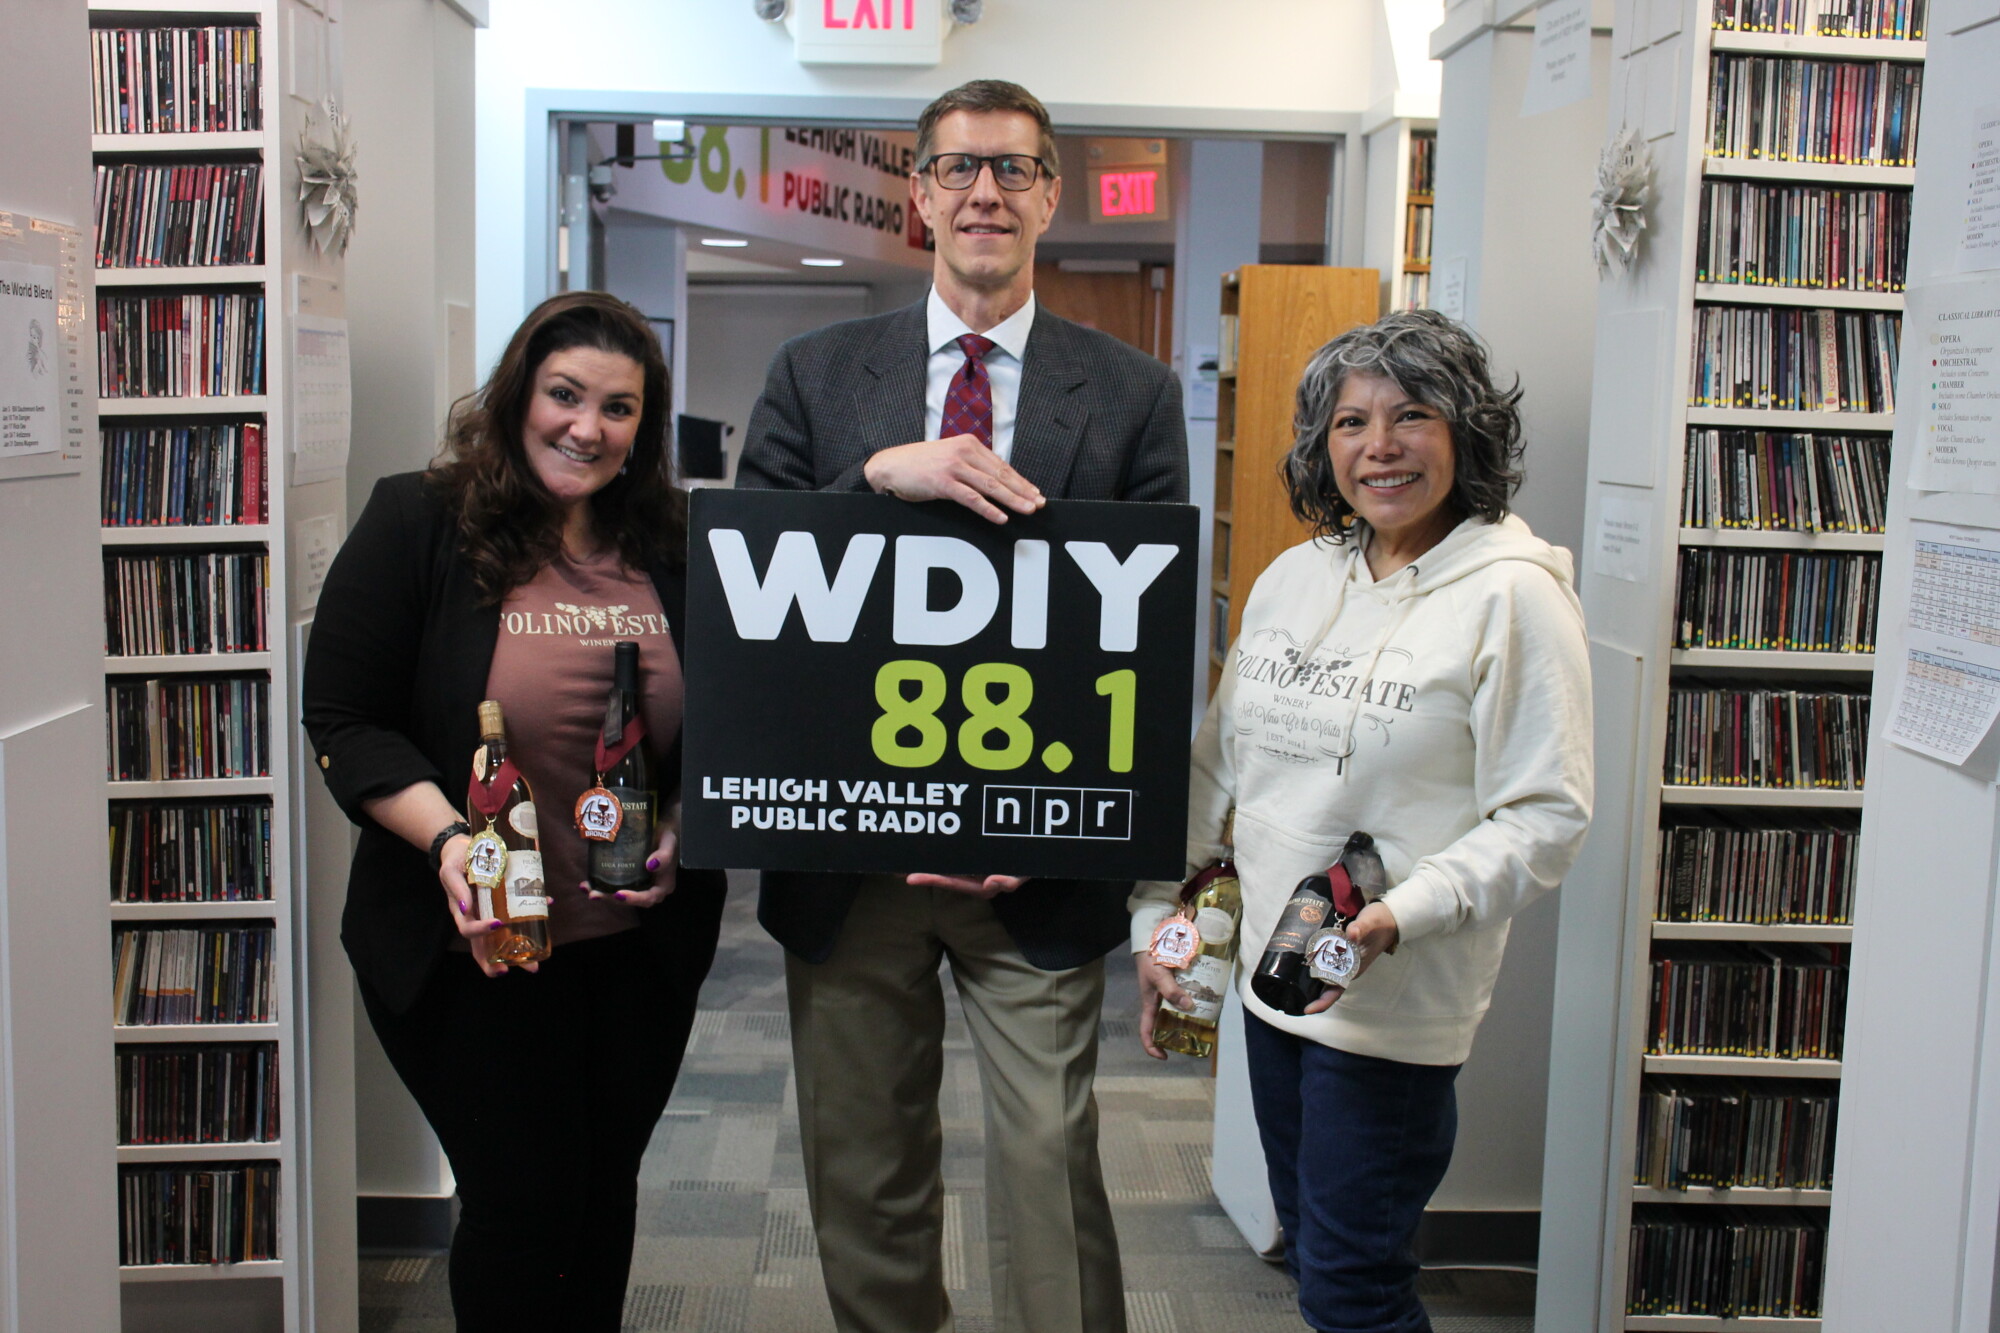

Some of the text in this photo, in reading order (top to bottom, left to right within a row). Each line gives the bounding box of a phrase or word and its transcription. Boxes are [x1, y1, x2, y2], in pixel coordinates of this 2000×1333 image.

[859, 131, 918, 180] VALLE
[784, 171, 849, 222] PUBLIC
[853, 191, 904, 235] RADIO
[1100, 171, 1158, 216] EXIT
[11, 282, 33, 298] World
[34, 285, 53, 300] Blend
[1938, 312, 1970, 321] CLASSICAL
[1940, 334, 1961, 343] OPERA
[1940, 358, 1978, 367] ORCHESTRAL
[1939, 381, 1965, 389] CHAMBER
[1937, 424, 1953, 432] VOCAL
[1935, 446, 1957, 454] MODERN
[708, 528, 1180, 652] WDIY
[500, 612, 590, 635] OLINO
[1237, 650, 1417, 712] OLINO ESTATE
[1273, 694, 1312, 709] WINERY
[871, 660, 1136, 773] 88.1
[702, 776, 969, 806] LEHIGH VALLEY
[622, 801, 648, 810] ESTATE
[996, 794, 1116, 835] npr
[731, 806, 962, 835] PUBLIC RADIO
